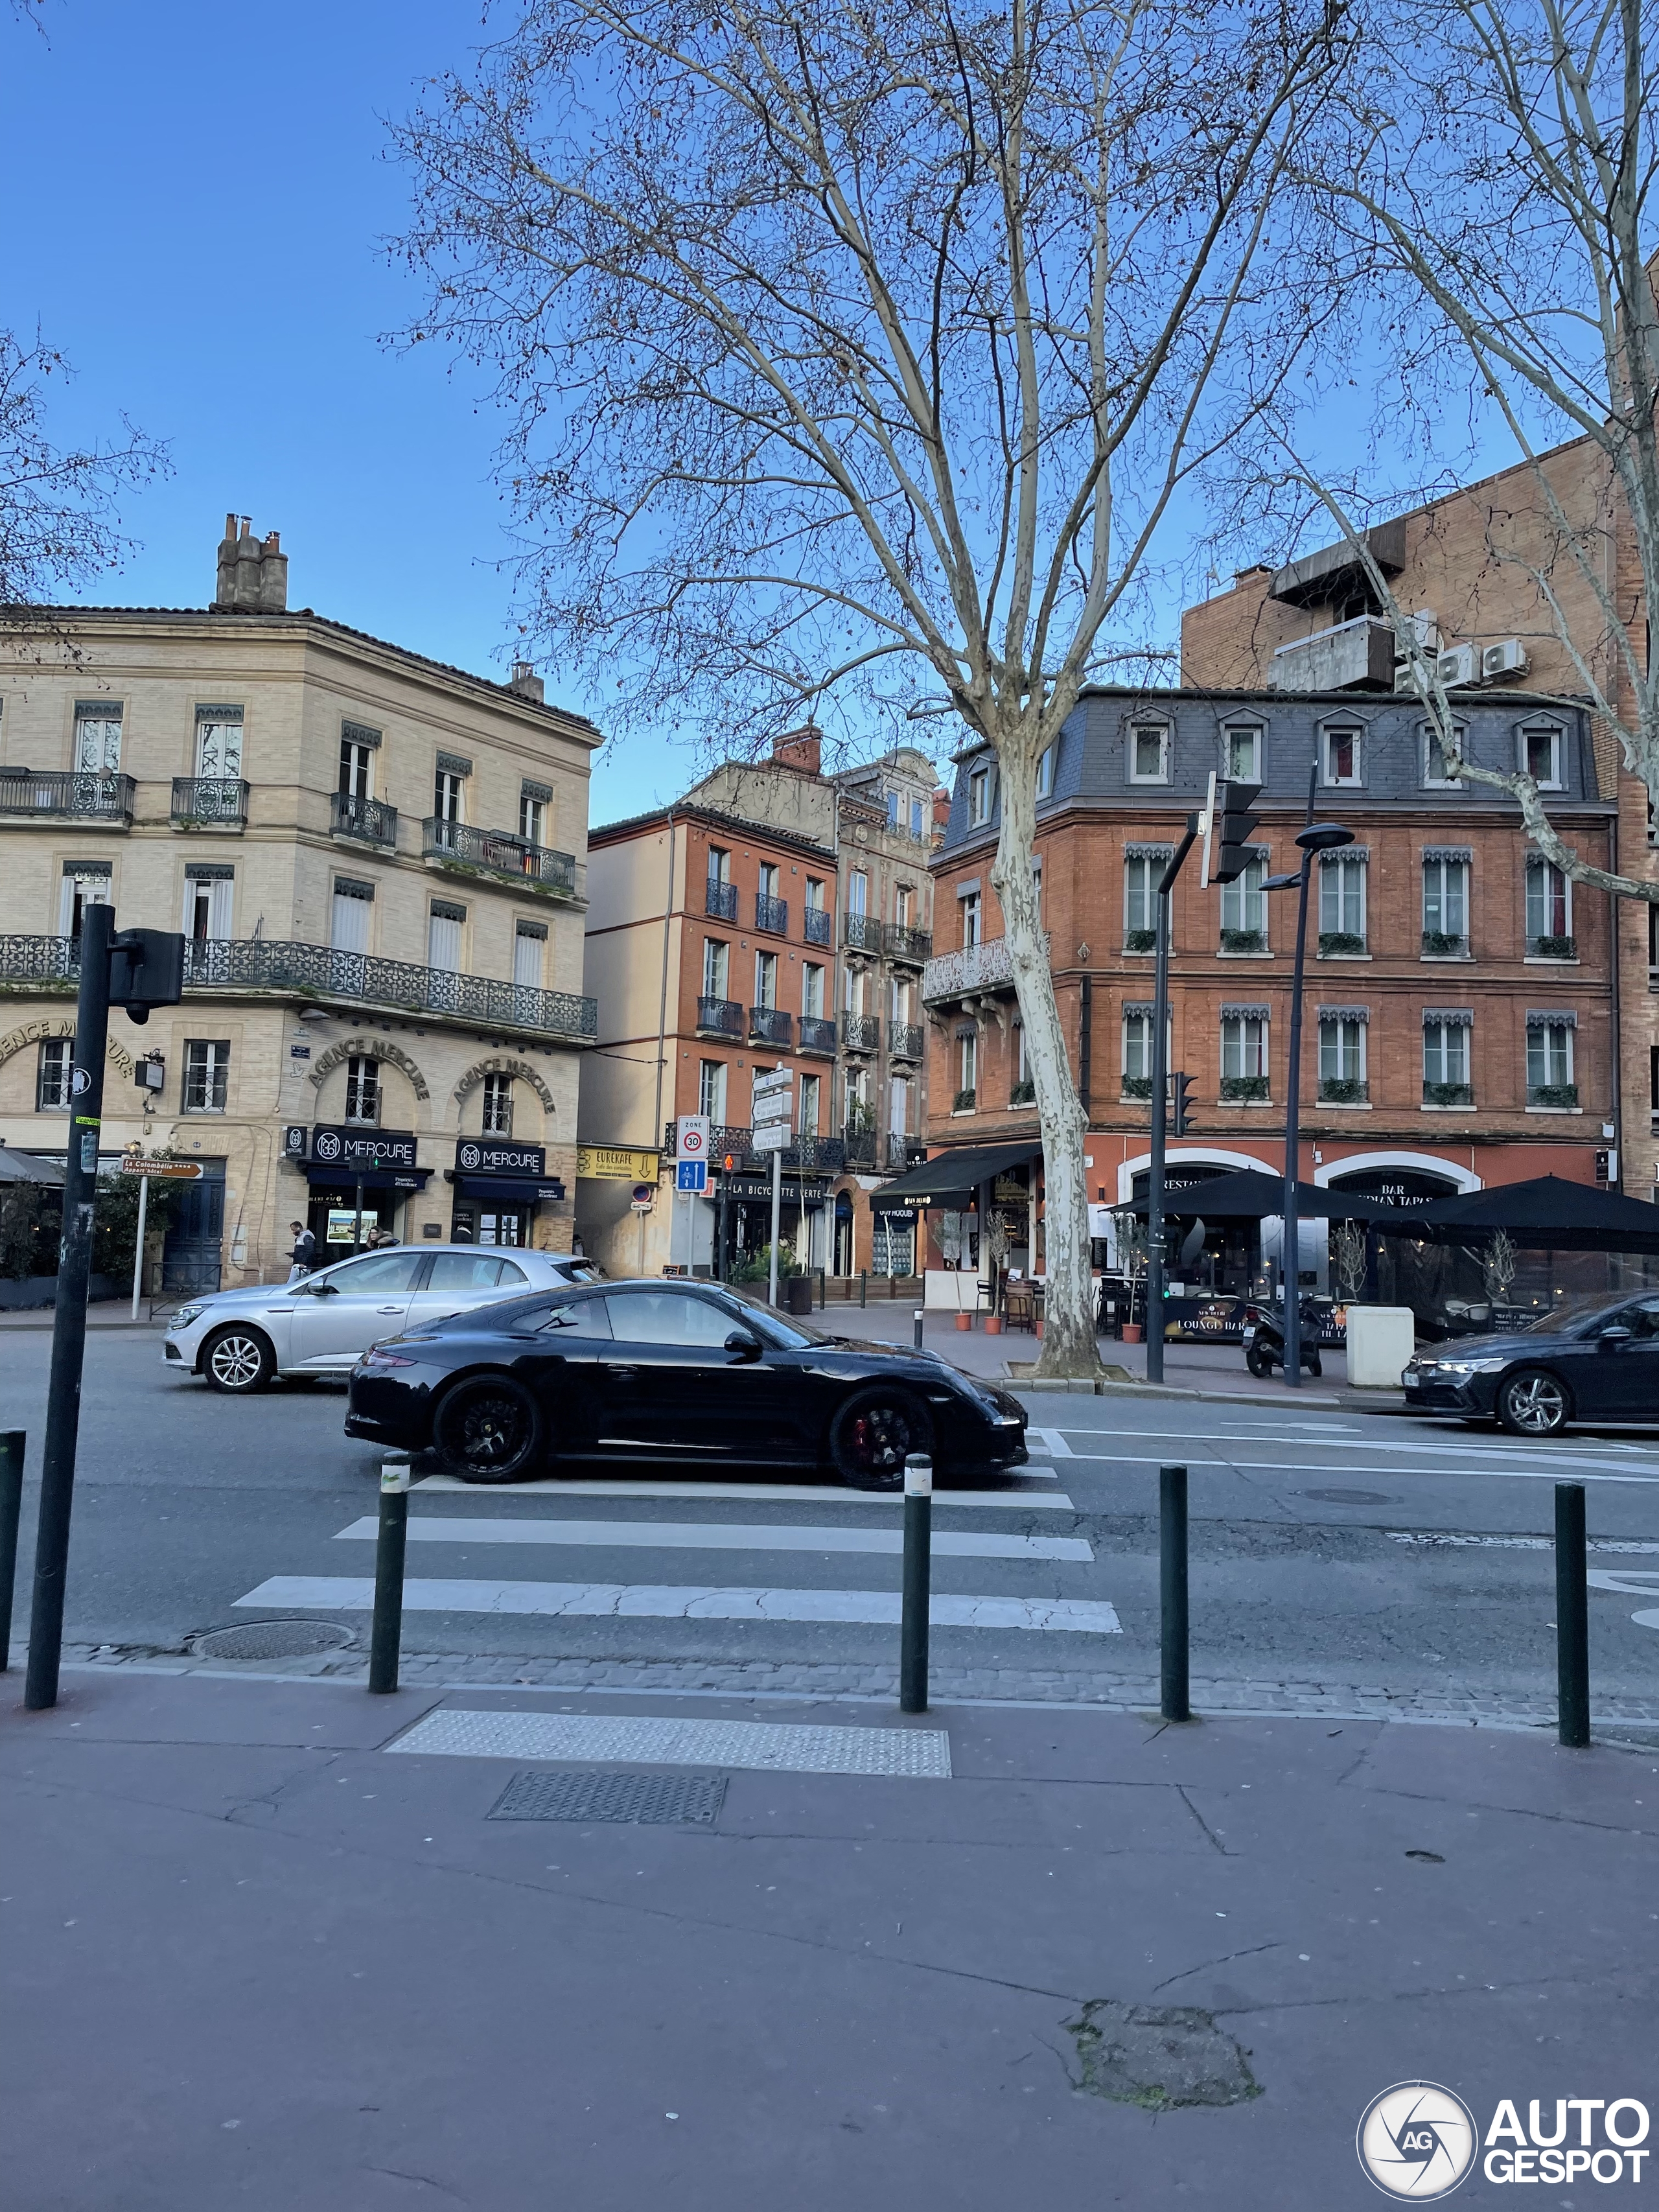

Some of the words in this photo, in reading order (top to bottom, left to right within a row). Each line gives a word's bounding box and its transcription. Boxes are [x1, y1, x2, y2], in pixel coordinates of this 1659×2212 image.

[308, 1039, 365, 1089] AGENCE
[371, 1040, 430, 1101] MERCURE
[454, 1058, 502, 1106] AGENCE
[506, 1059, 556, 1115] MERCURE
[688, 1137, 699, 1146] 30
[345, 1140, 413, 1159] MERCURE
[483, 1151, 540, 1168] MERCURE
[733, 1185, 742, 1193] LA
[748, 1185, 794, 1196] BICYCTTE
[1382, 1185, 1404, 1194] BAR
[1178, 1320, 1219, 1330] LOUNGE
[1225, 1321, 1245, 1331] BAR
